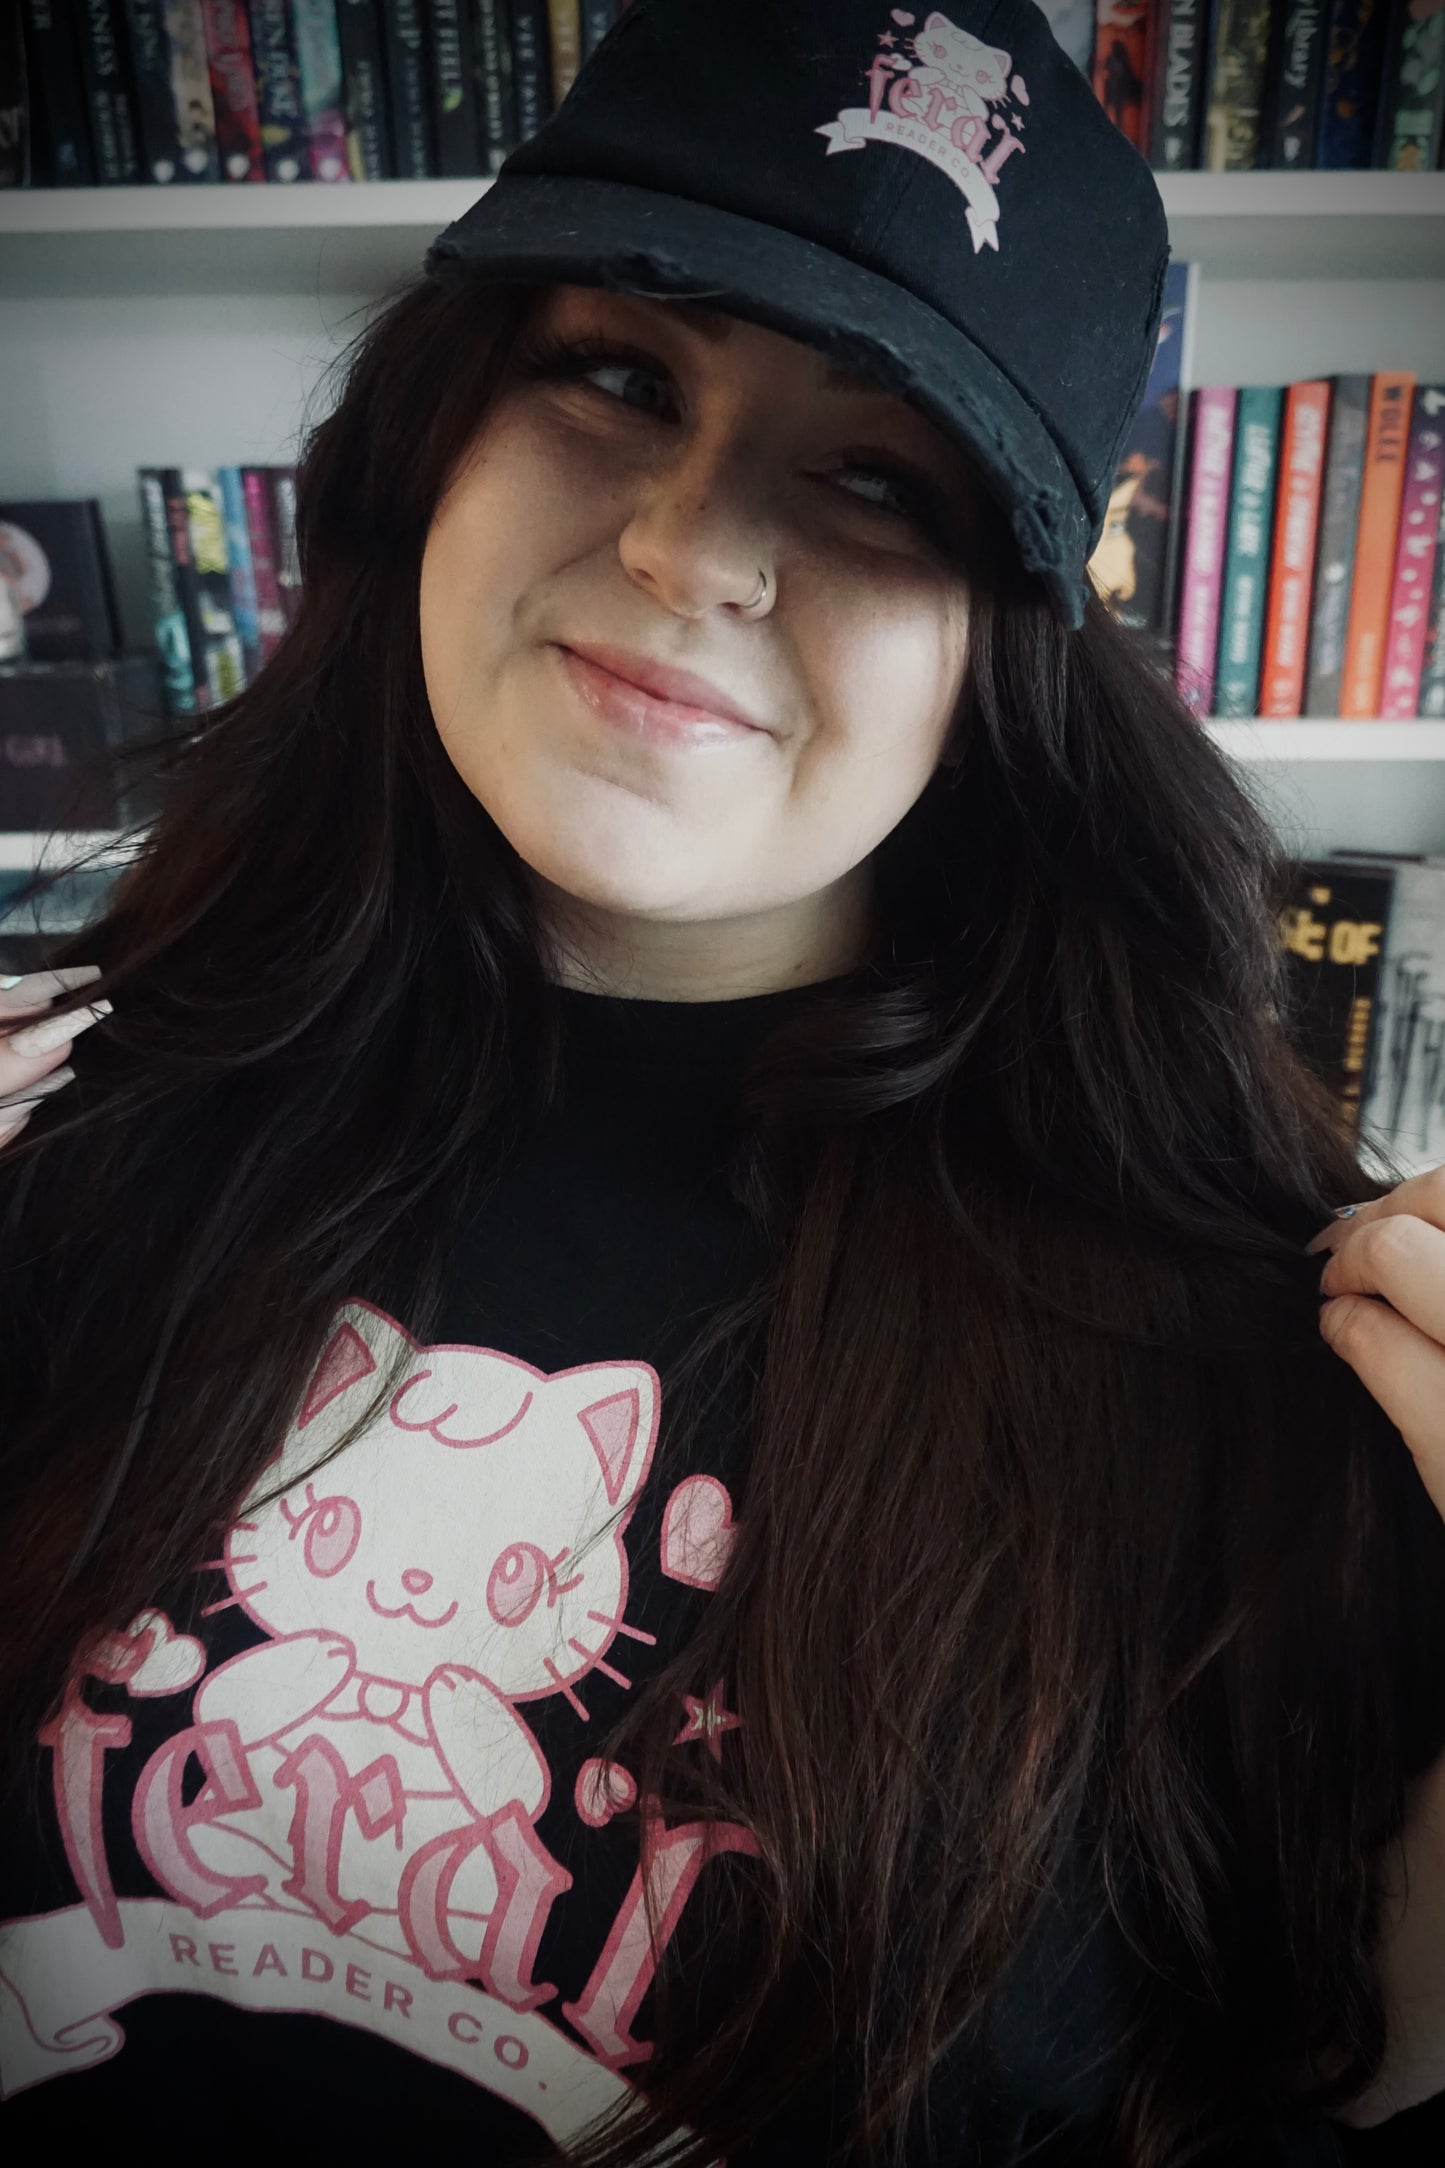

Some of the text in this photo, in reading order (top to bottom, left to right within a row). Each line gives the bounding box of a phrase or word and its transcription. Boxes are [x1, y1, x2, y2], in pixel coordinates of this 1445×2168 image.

[865, 54, 1026, 184] feral
[886, 122, 947, 155] READER
[39, 1625, 763, 2064] feral
[169, 1933, 550, 2092] READER CO.
